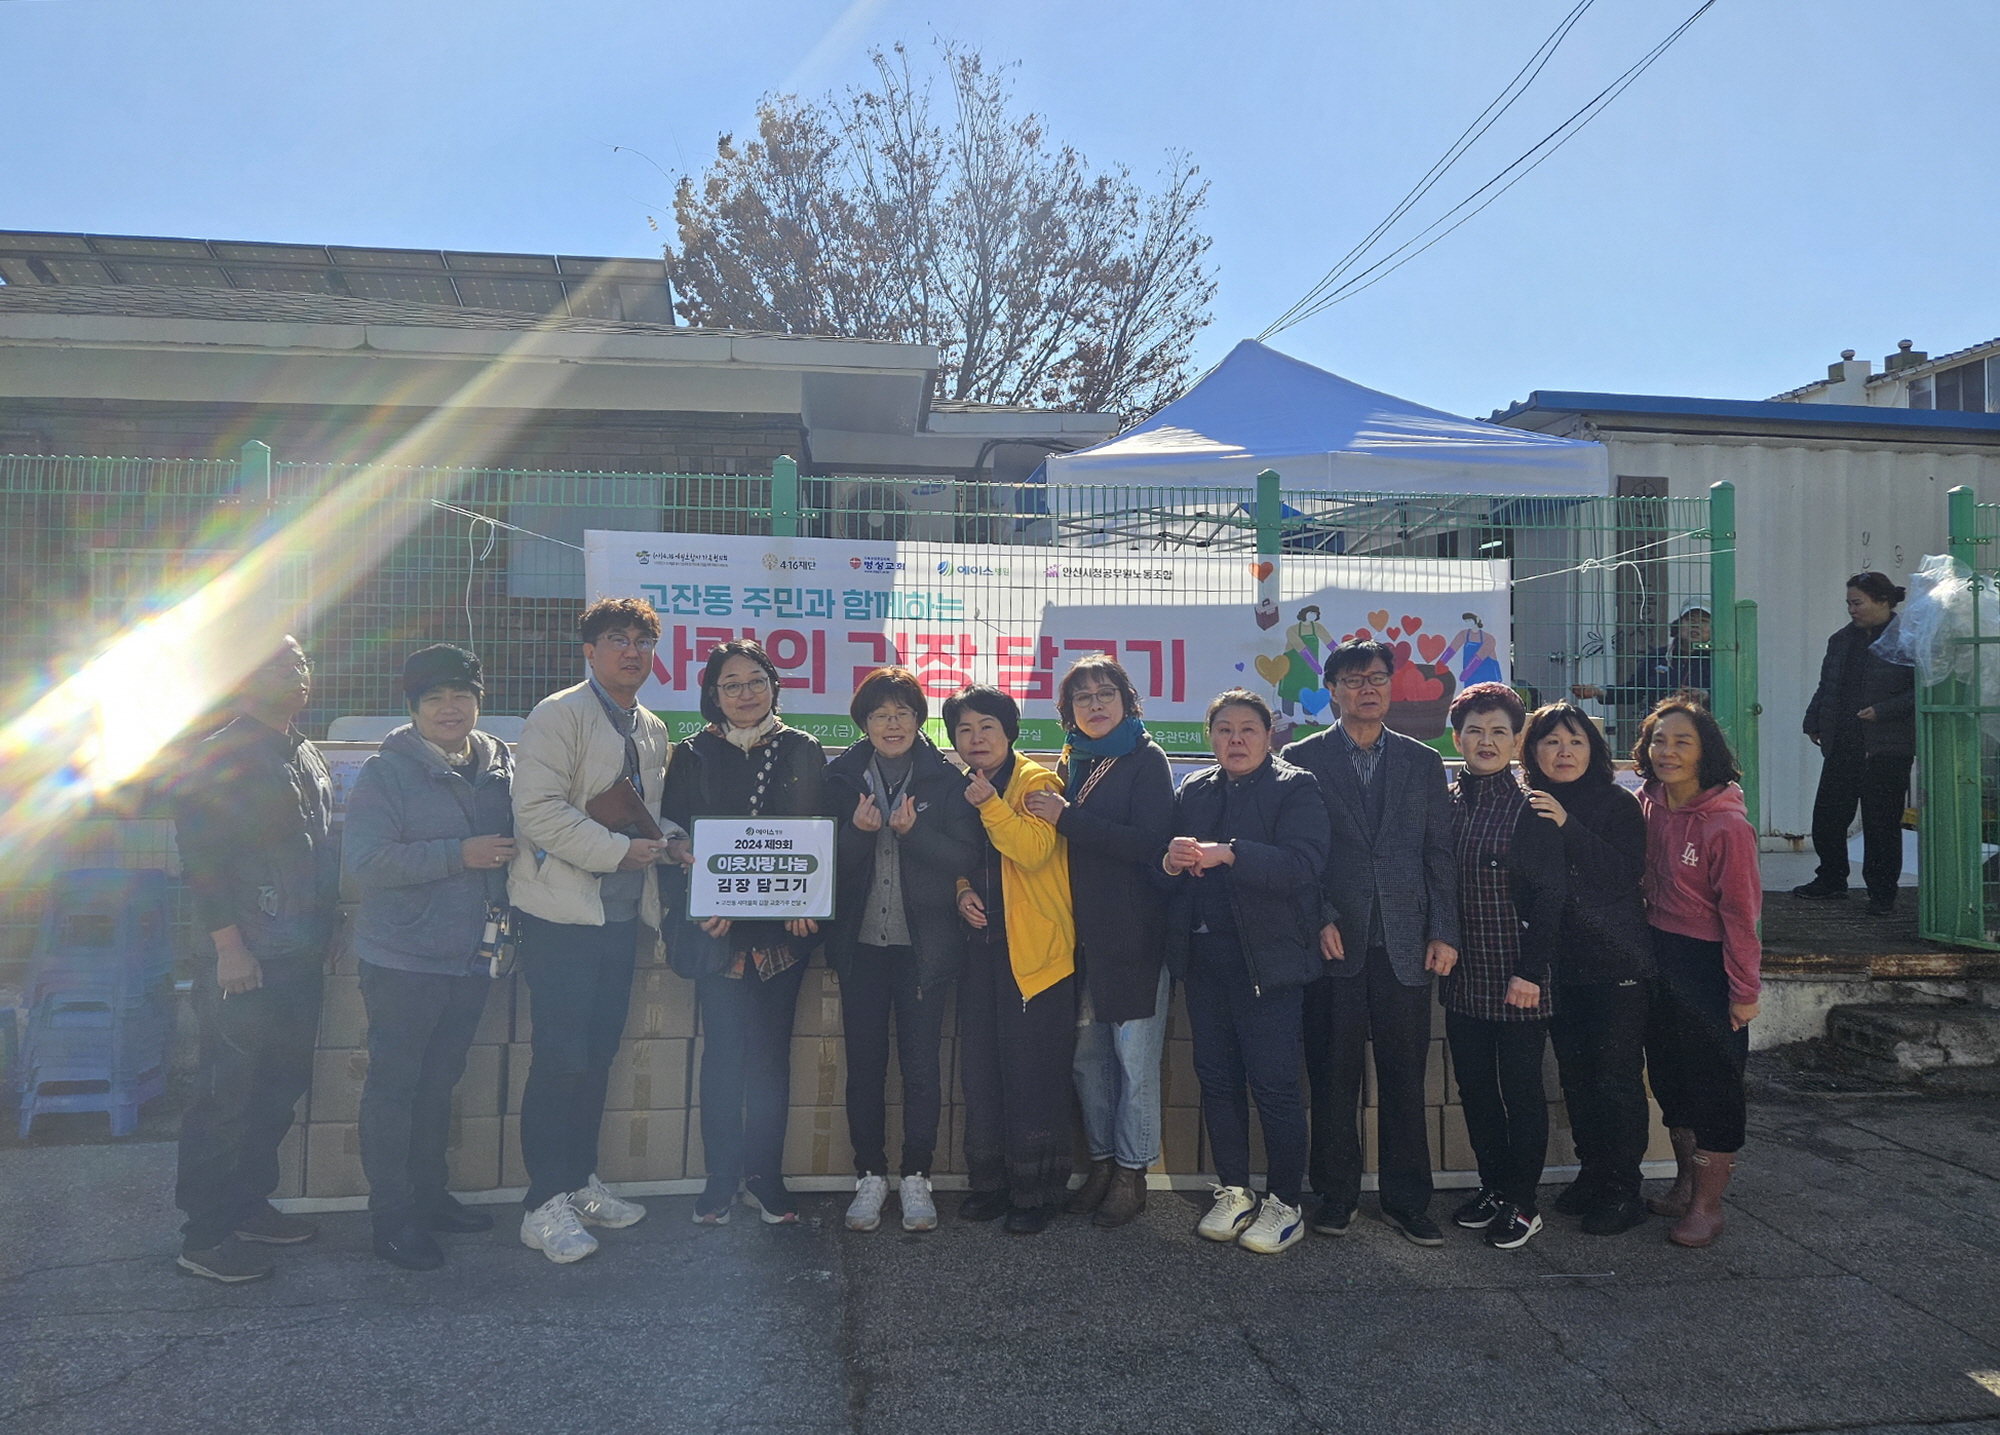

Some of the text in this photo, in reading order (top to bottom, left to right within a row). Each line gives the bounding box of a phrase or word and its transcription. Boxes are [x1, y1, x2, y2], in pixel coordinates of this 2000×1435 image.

[863, 561, 906, 571] 명성교회
[1062, 567, 1173, 580] 안산시청공무원노동조합
[640, 584, 965, 622] 고잔동 주민과 함께하는
[678, 721, 708, 733] 202
[734, 839, 793, 850] 2024 제9회
[1681, 841, 1699, 867] LA
[717, 856, 808, 872] 이웃사랑 나눔
[717, 878, 807, 893] 김장 담그기
[584, 1201, 601, 1213] N
[541, 1225, 553, 1238] N
